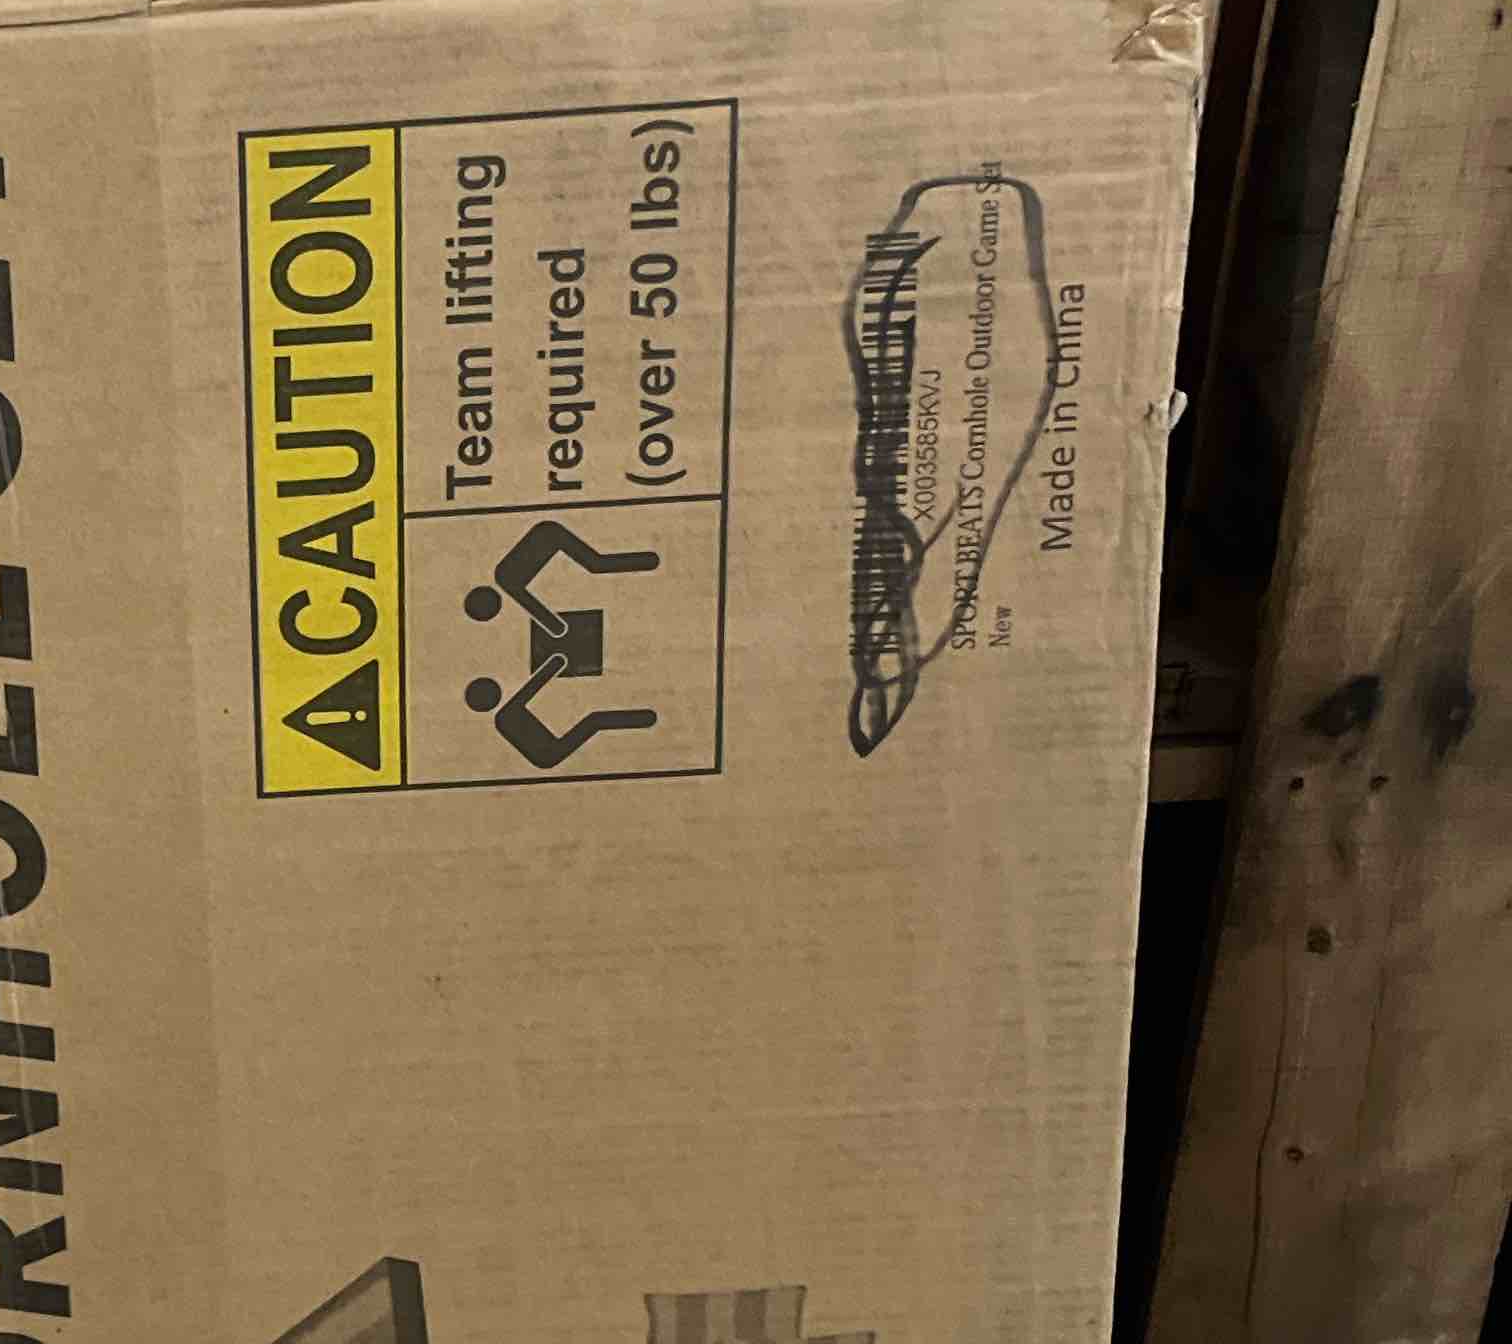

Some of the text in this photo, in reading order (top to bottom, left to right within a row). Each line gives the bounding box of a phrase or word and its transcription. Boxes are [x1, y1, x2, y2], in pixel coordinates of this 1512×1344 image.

[269, 144, 379, 657] CAUTION
[442, 155, 506, 500] Team lifting
[536, 248, 596, 491] required
[625, 119, 695, 487] (over 50 lbs)
[912, 368, 942, 523] X003585KVJ
[951, 159, 1003, 651] SPORT BEATS Cornhole Outdoor Game Set
[1039, 282, 1085, 553] Made in China
[988, 605, 1014, 648] New
